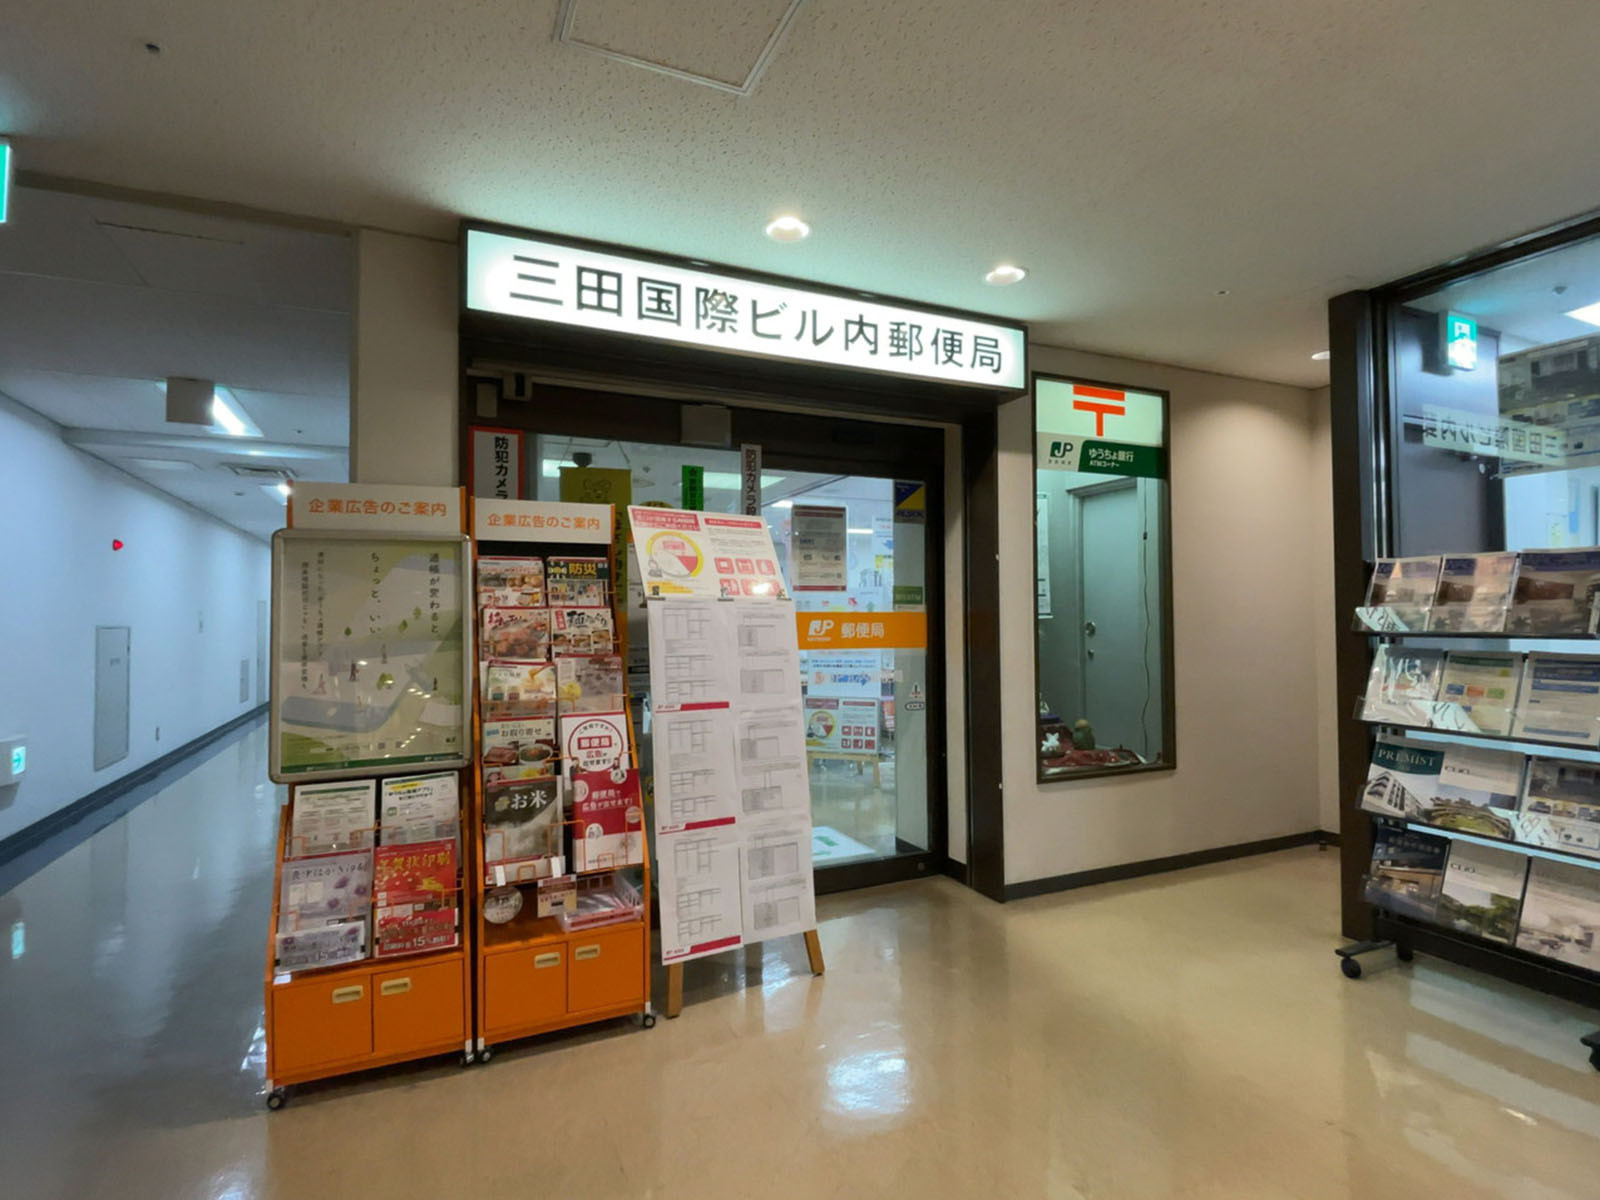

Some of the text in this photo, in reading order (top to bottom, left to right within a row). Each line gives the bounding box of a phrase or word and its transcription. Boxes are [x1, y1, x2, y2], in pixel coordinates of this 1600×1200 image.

[510, 254, 1003, 374] 三田国際ビル内郵便局
[1088, 448, 1134, 462] ゆうちょ銀行
[494, 435, 509, 499] 防犯カメラ
[308, 497, 447, 517] 企業広告のご案内
[487, 512, 601, 531] 企業広告のご案内
[568, 562, 597, 576] 防災
[841, 622, 885, 638] 郵便局
[510, 789, 547, 810] お米
